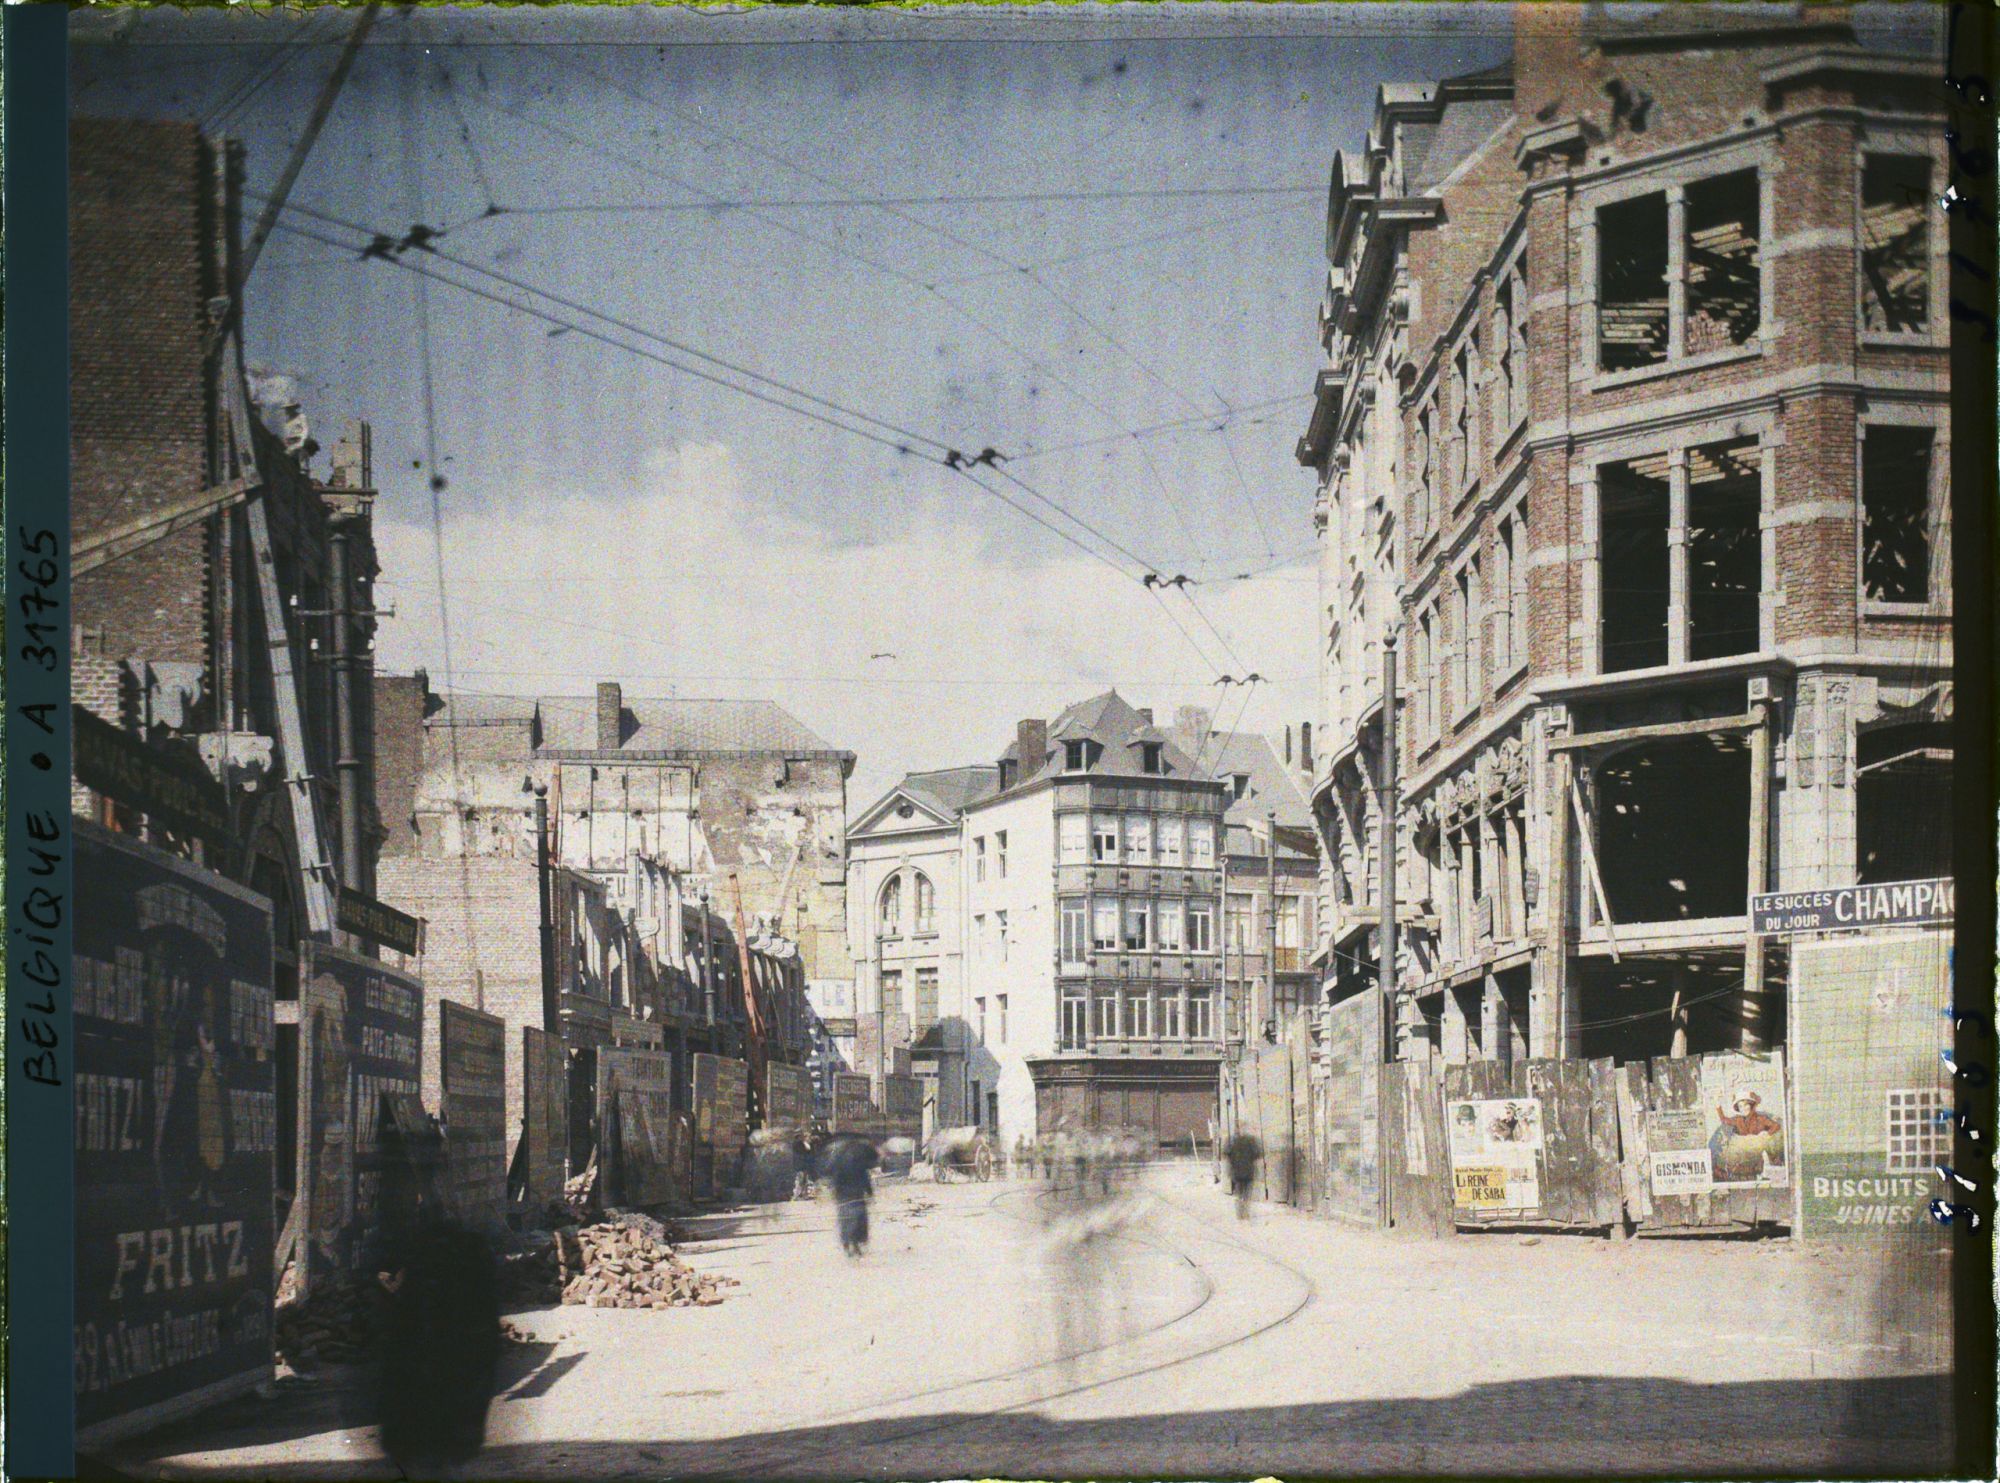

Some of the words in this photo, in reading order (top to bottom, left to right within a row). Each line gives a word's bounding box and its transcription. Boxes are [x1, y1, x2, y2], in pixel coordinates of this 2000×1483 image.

[1754, 897, 1772, 912] LE
[1834, 883, 1954, 922] CHAMPA
[1766, 917, 1781, 931] DU
[1784, 913, 1820, 929] JOUR
[1656, 1161, 1707, 1176] GISMONDA
[1472, 1188, 1481, 1200] DE
[1483, 1187, 1505, 1200] SABA
[1814, 1177, 1930, 1198] BISCUITS
[109, 1220, 249, 1300] FRITZ
